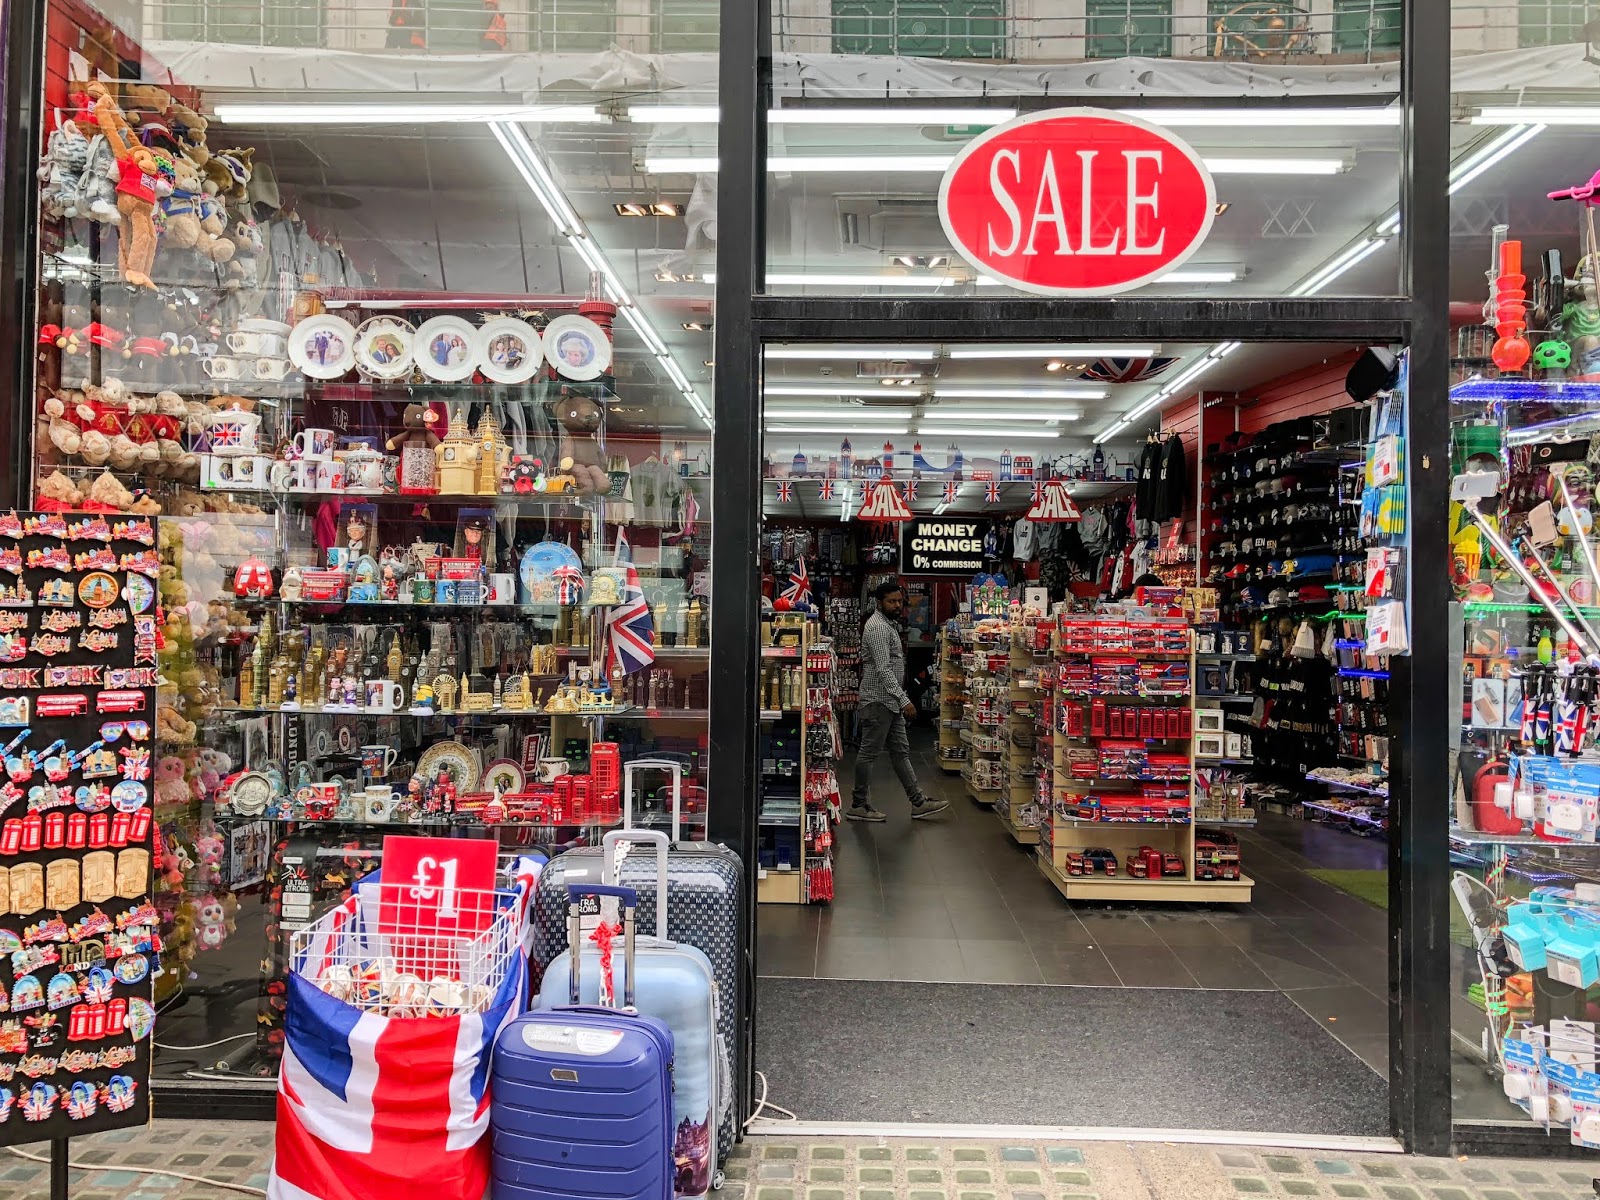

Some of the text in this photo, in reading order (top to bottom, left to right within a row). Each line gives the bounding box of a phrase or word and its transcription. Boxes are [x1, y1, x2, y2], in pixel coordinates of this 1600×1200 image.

[987, 148, 1166, 257] SALE
[860, 484, 912, 517] SALE
[1027, 485, 1081, 518] SALE
[918, 523, 977, 537] MONEY
[911, 538, 982, 552] CHANGE
[913, 554, 982, 569] 0% COMMISSION
[1555, 830, 1583, 840] PIFCO
[410, 856, 458, 919] £1
[580, 898, 595, 906] TRA
[568, 905, 598, 914] RONG
